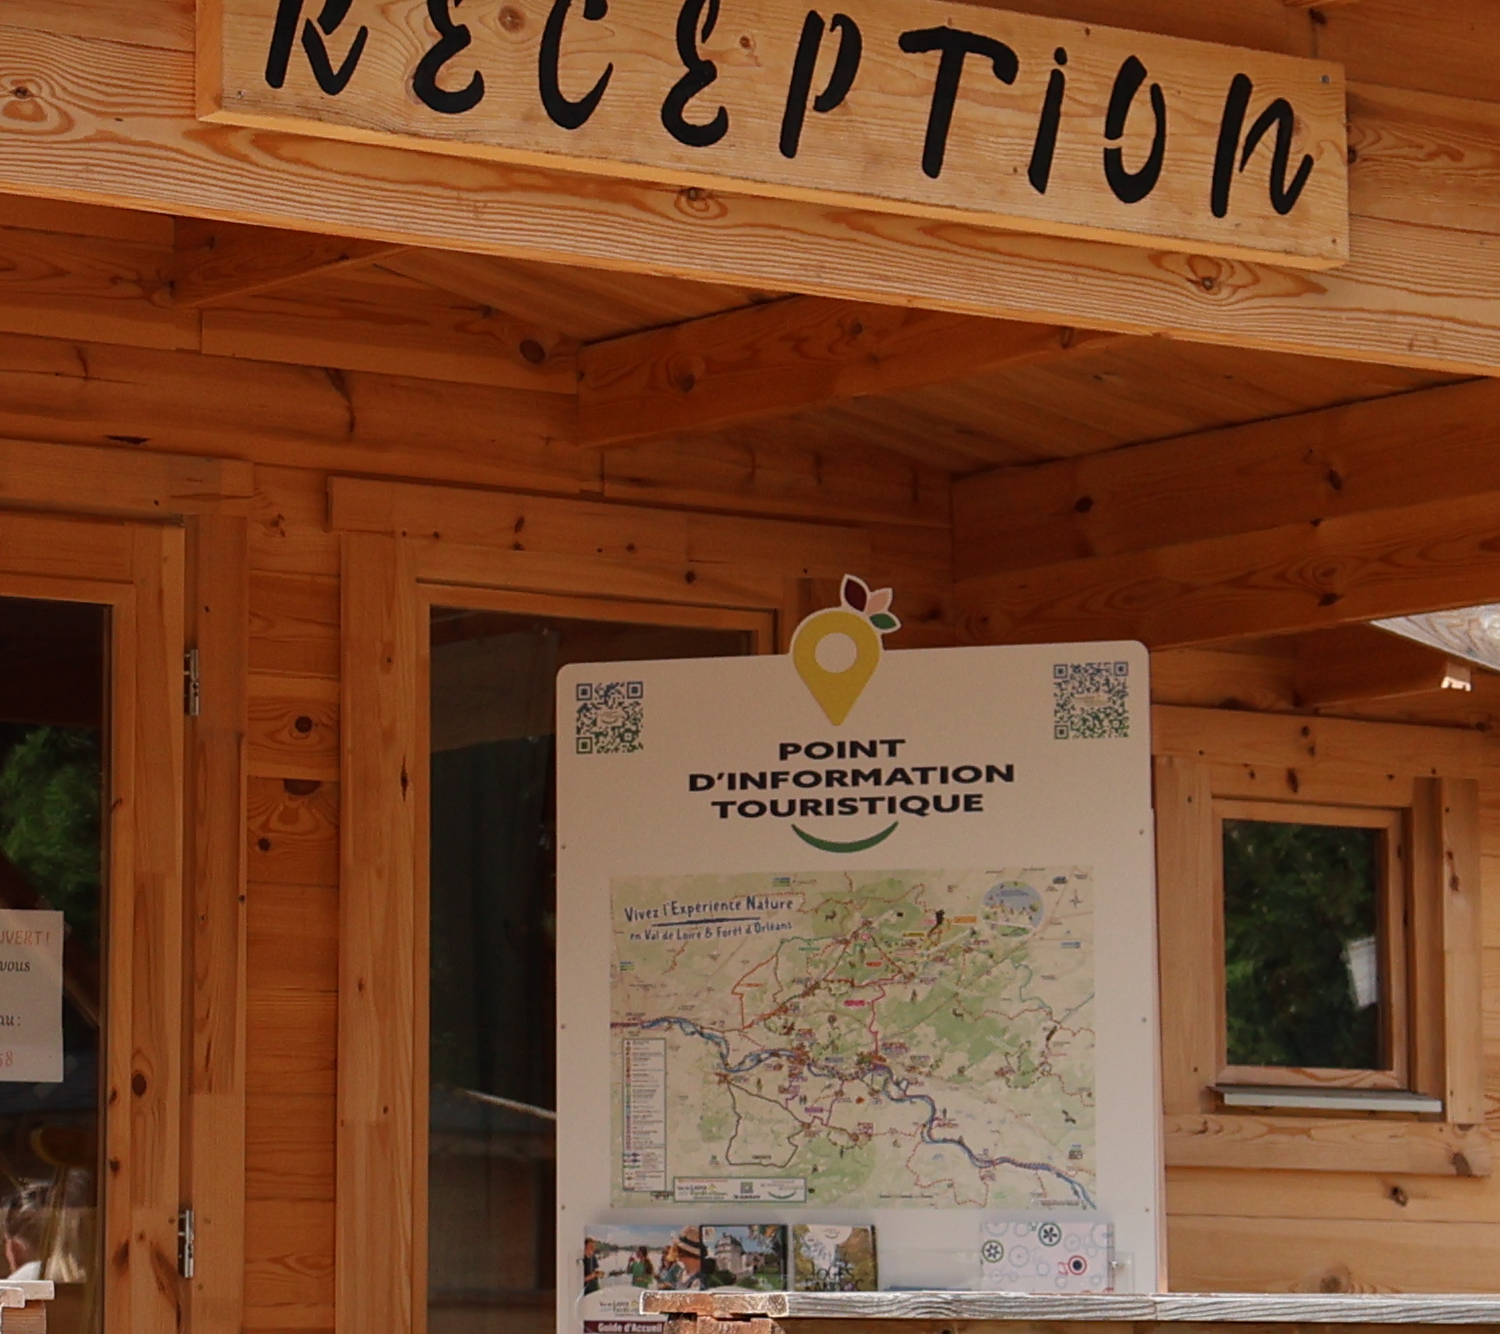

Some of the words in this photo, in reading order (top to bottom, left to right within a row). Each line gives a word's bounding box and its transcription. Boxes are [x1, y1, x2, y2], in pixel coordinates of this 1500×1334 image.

[778, 738, 906, 761] POINT
[688, 763, 1015, 792] D'INFORMATION
[711, 793, 984, 820] TOURISTIQUE
[624, 906, 659, 922] Vivez
[746, 895, 793, 910] Nature
[645, 929, 659, 940] Val
[662, 930, 674, 940] de
[0, 960, 31, 972] vous
[598, 1322, 623, 1333] Guide
